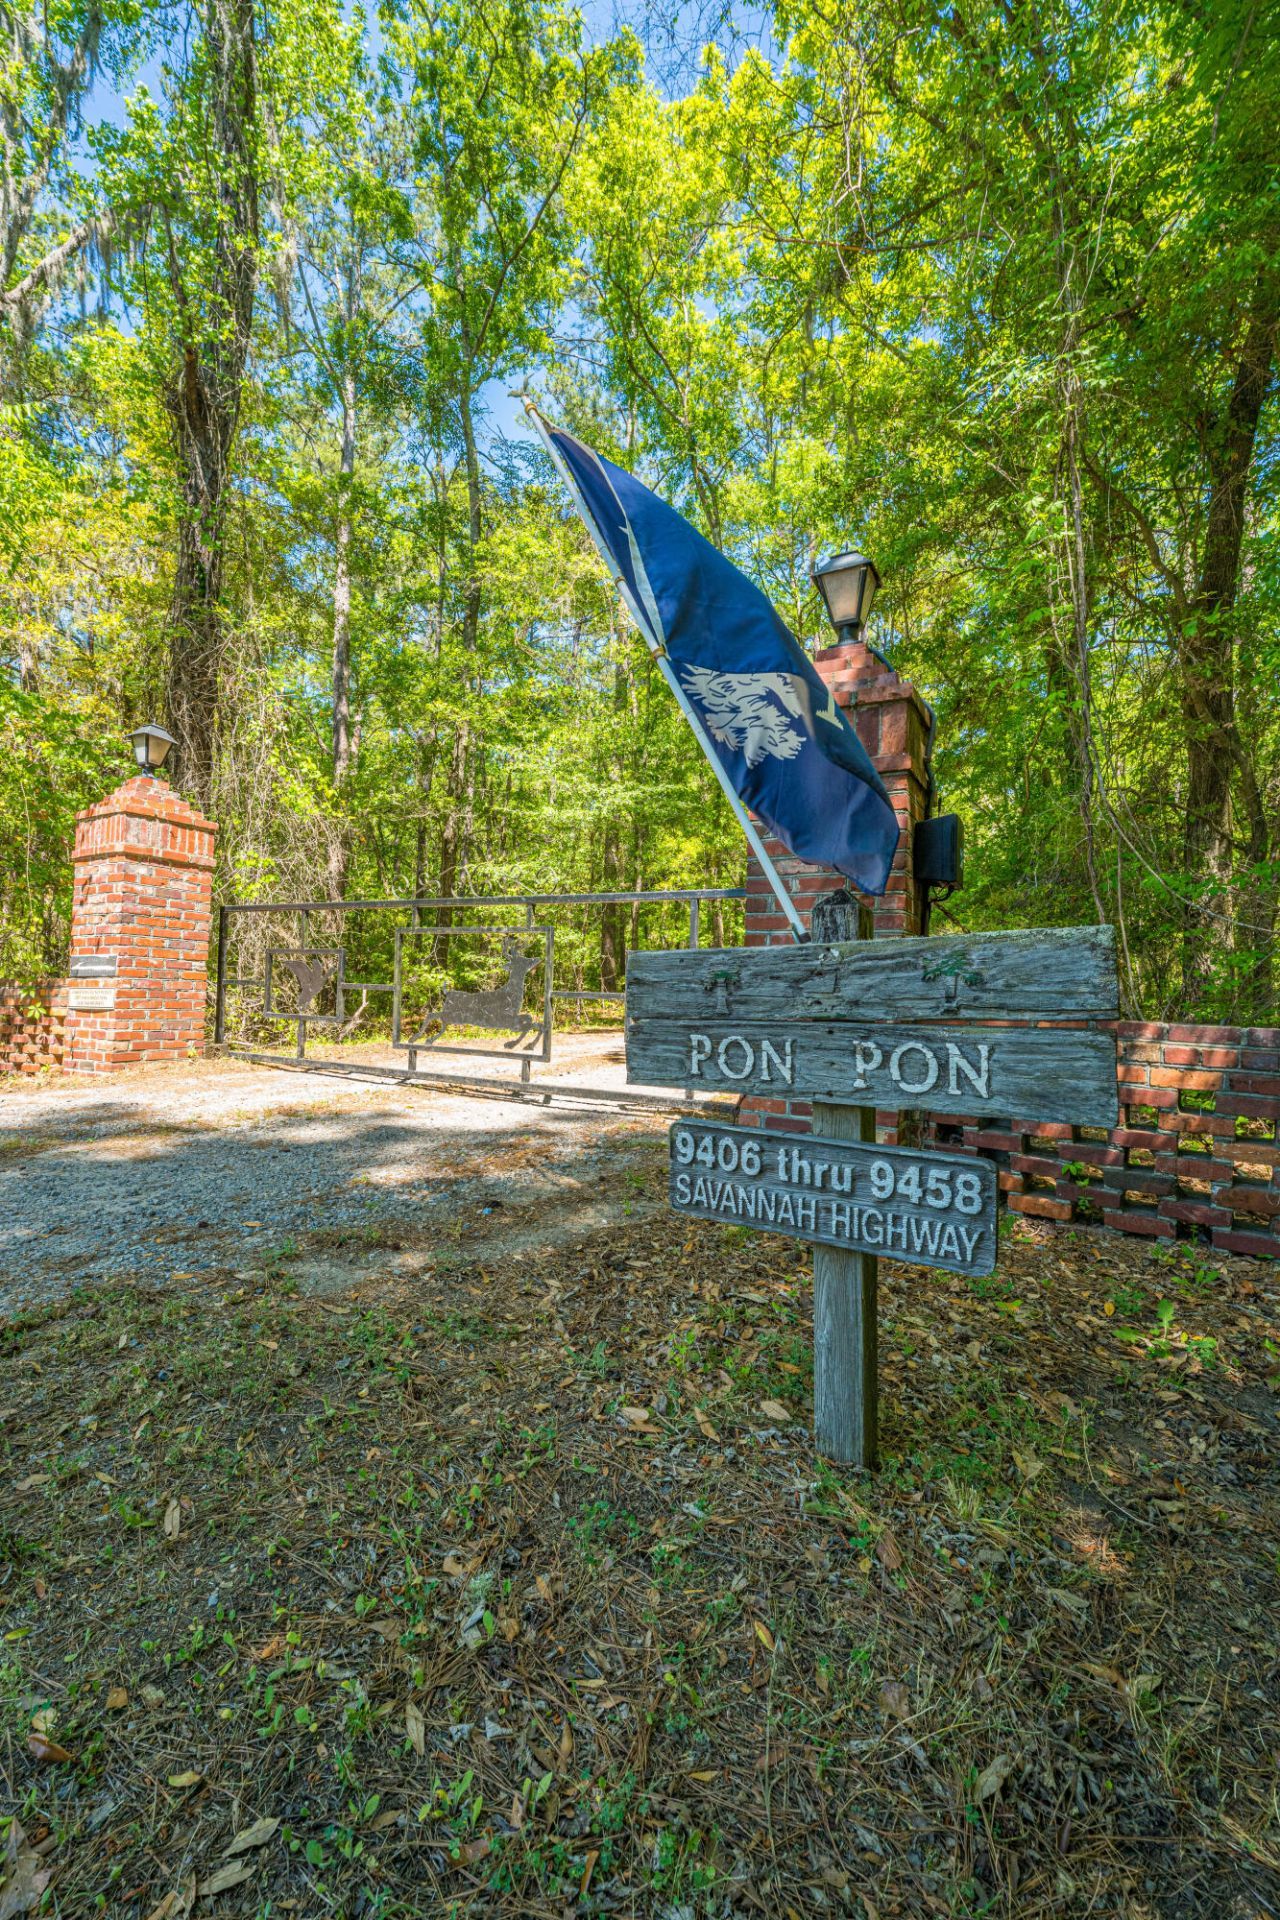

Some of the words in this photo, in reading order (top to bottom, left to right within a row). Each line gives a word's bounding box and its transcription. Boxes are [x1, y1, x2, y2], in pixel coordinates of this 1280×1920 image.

[690, 1034, 794, 1083] PON
[853, 1040, 990, 1098] PON
[675, 1132, 762, 1175] 9406
[778, 1147, 853, 1192] thru
[870, 1161, 982, 1215] 9458
[676, 1175, 817, 1230] SAVANNAH
[832, 1200, 980, 1262] HIGHWAY
